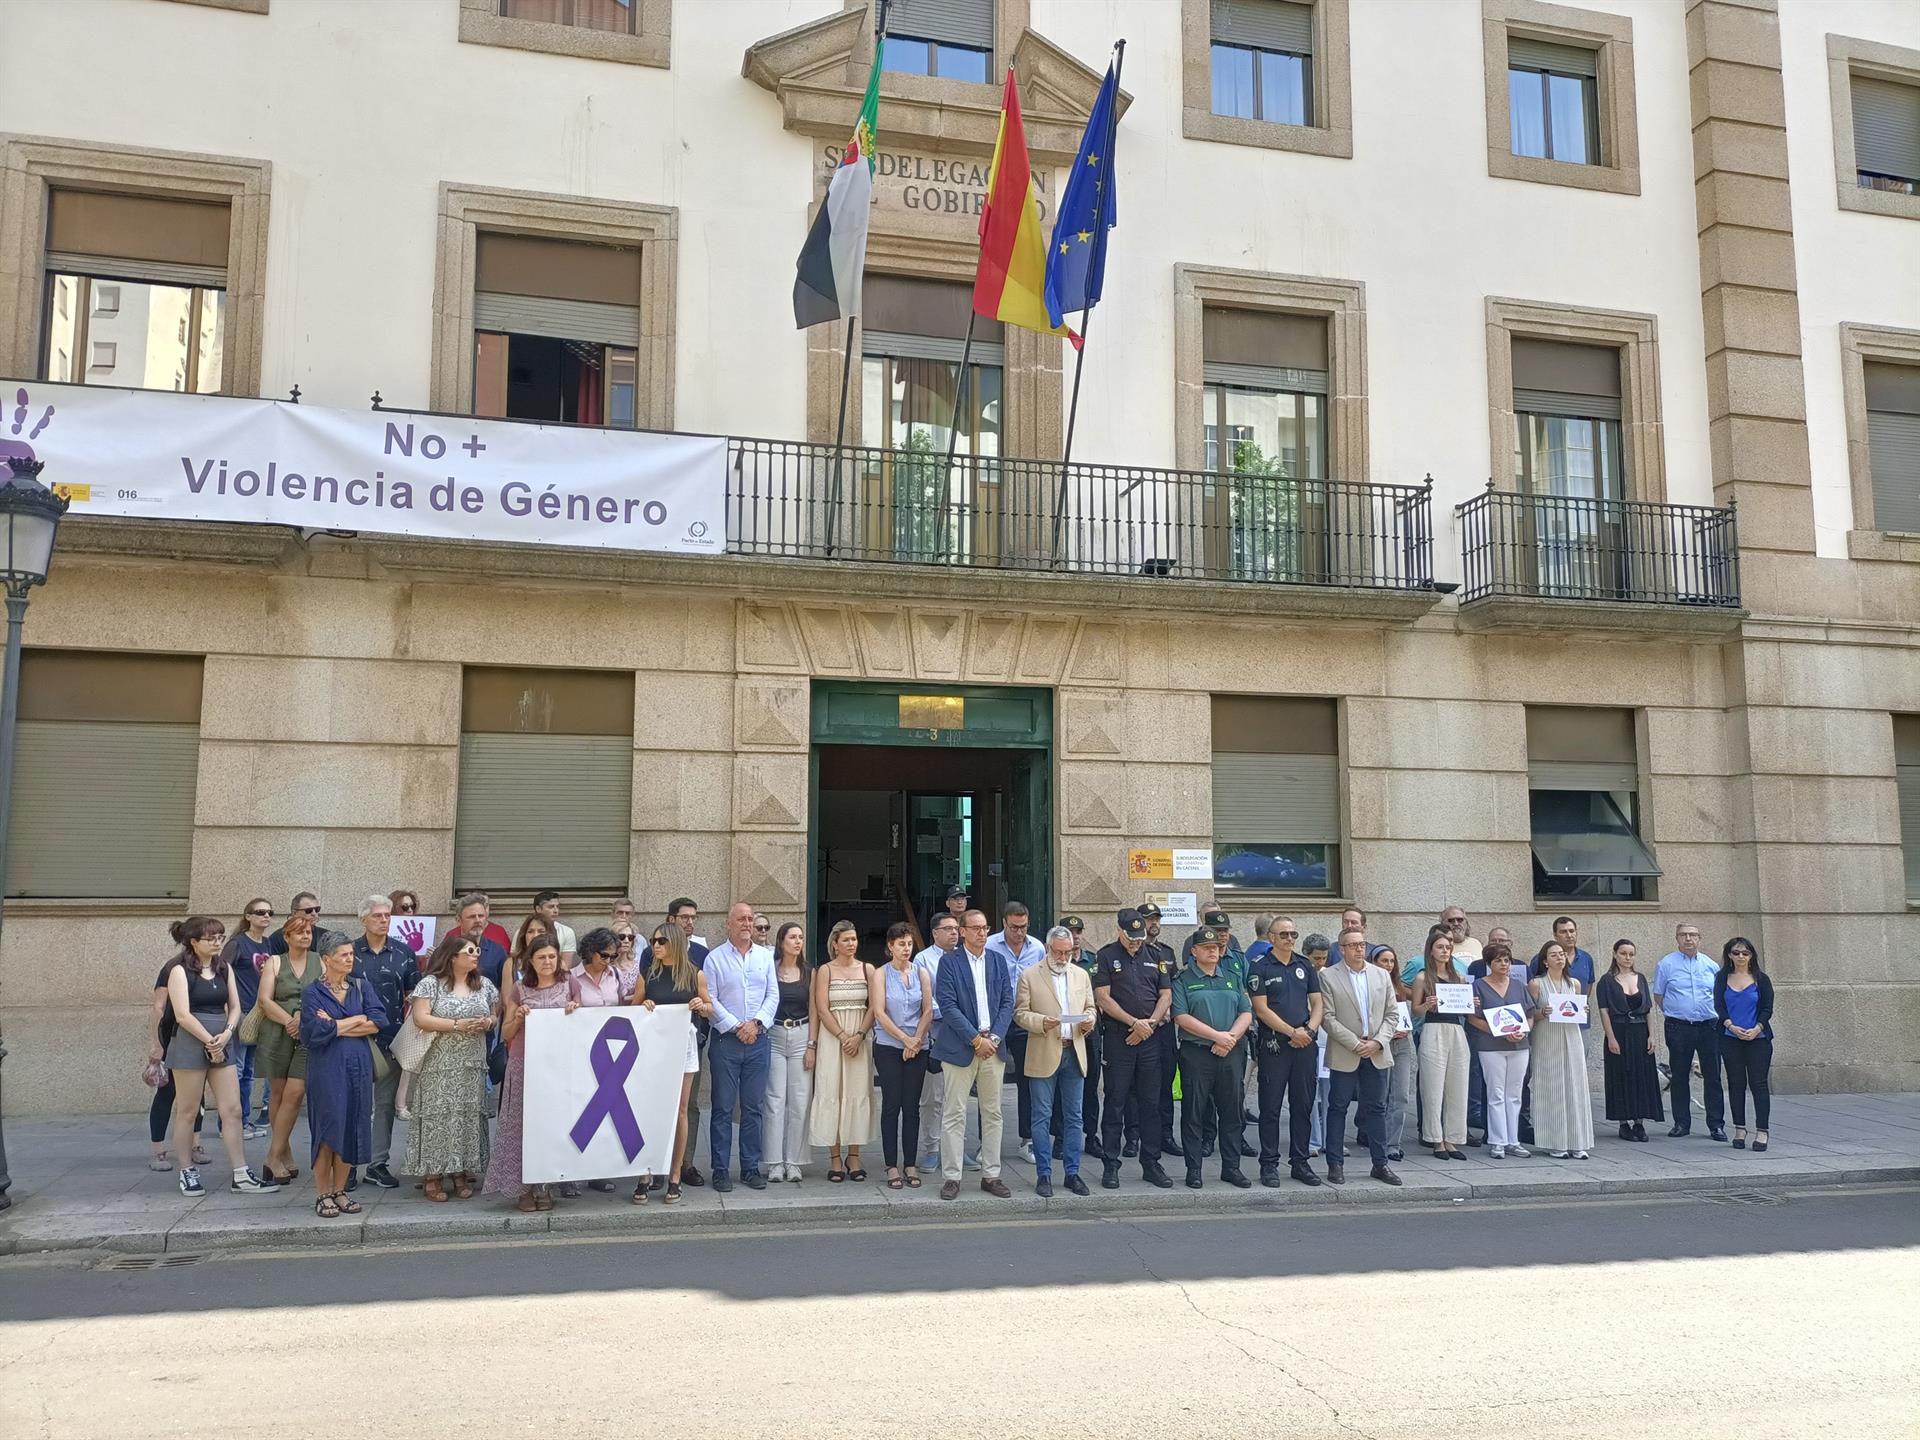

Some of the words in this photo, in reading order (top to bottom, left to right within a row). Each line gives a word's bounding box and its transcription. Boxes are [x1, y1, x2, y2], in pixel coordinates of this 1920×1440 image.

[384, 422, 446, 459] No
[462, 435, 486, 458] +
[117, 488, 138, 499] 016
[181, 457, 413, 509] Violencia
[429, 477, 484, 513] de
[500, 481, 667, 525] Género
[929, 728, 938, 741] 3
